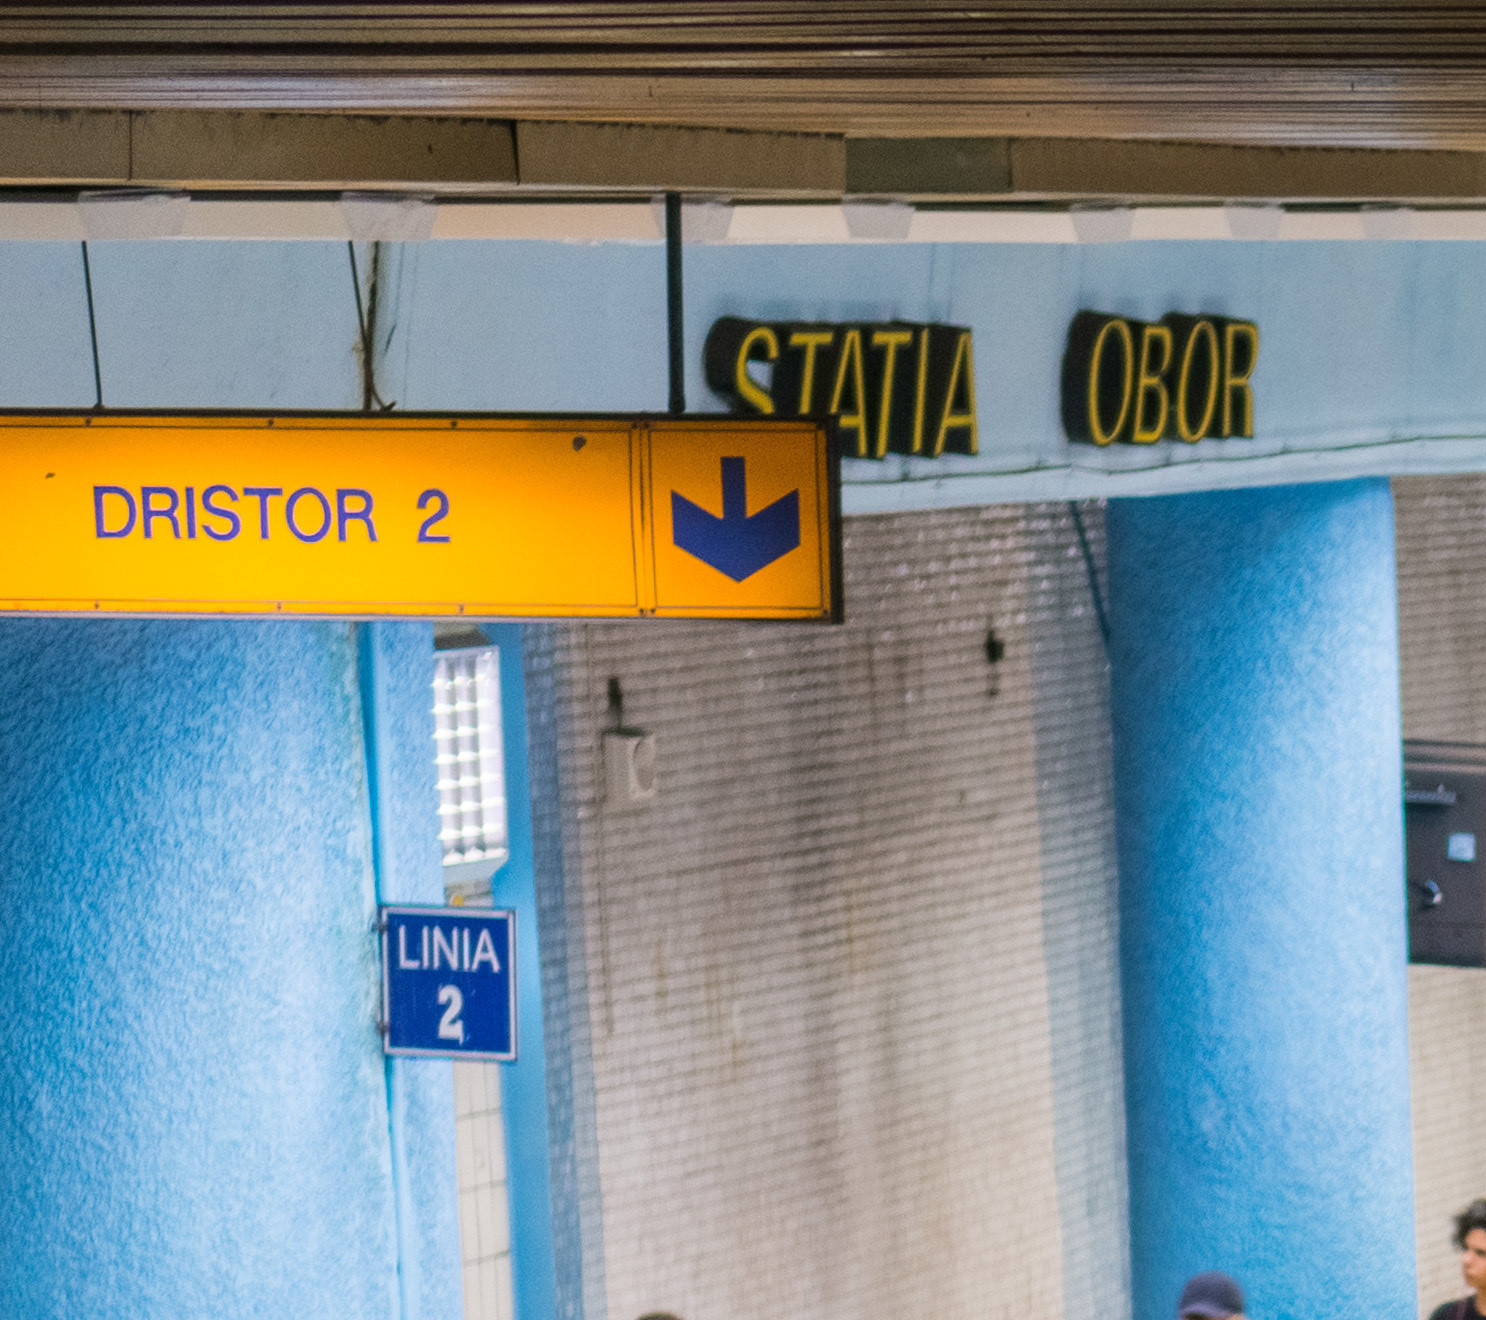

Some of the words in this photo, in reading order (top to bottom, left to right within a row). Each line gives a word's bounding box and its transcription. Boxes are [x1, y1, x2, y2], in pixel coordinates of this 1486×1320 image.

[1086, 317, 1260, 447] OBOR
[93, 484, 379, 543] DRISTOR
[416, 487, 452, 544] 2
[398, 924, 501, 973] LINIA
[437, 983, 465, 1043] 2
